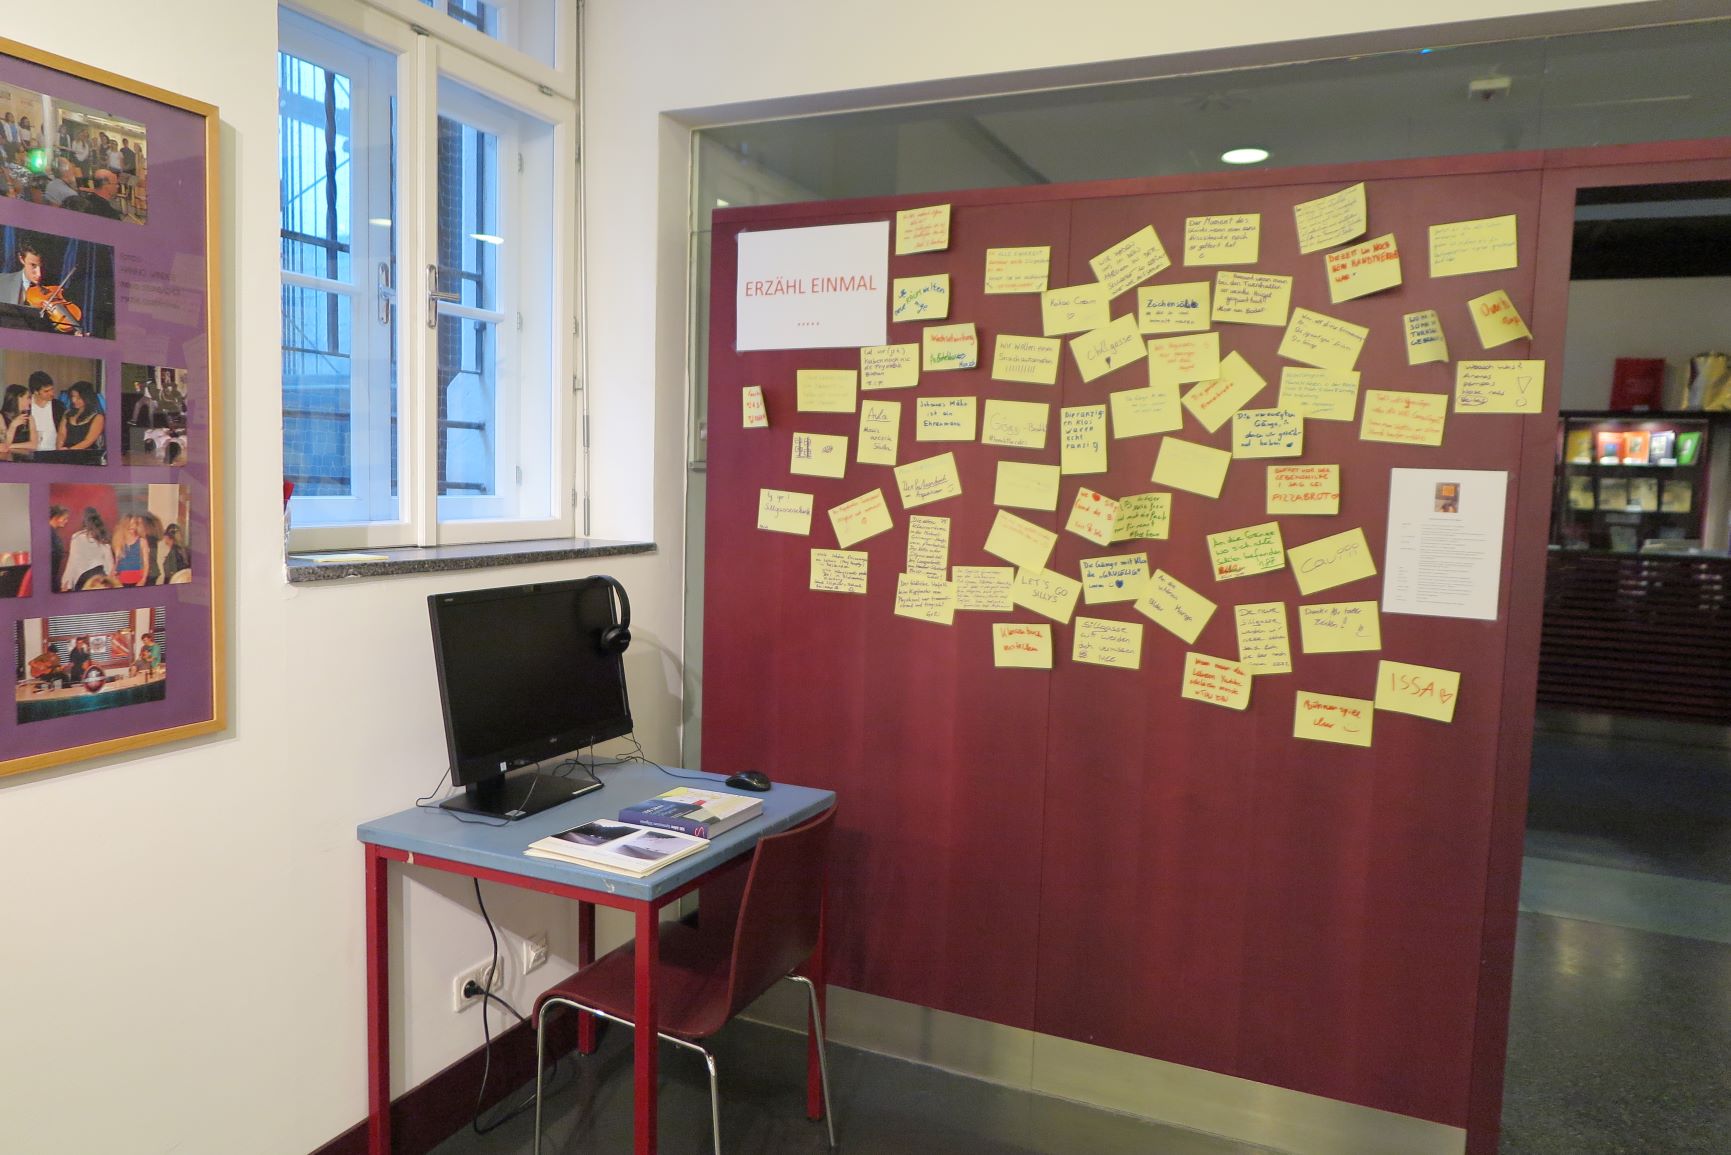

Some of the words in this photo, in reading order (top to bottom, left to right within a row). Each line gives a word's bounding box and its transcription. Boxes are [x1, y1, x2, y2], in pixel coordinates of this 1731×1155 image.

[745, 276, 806, 297] ERZÄHL
[811, 275, 877, 293] EINMAL
[1021, 576, 1050, 589] LET'S
[1054, 587, 1068, 597] GO
[1392, 672, 1435, 697] ISSA
